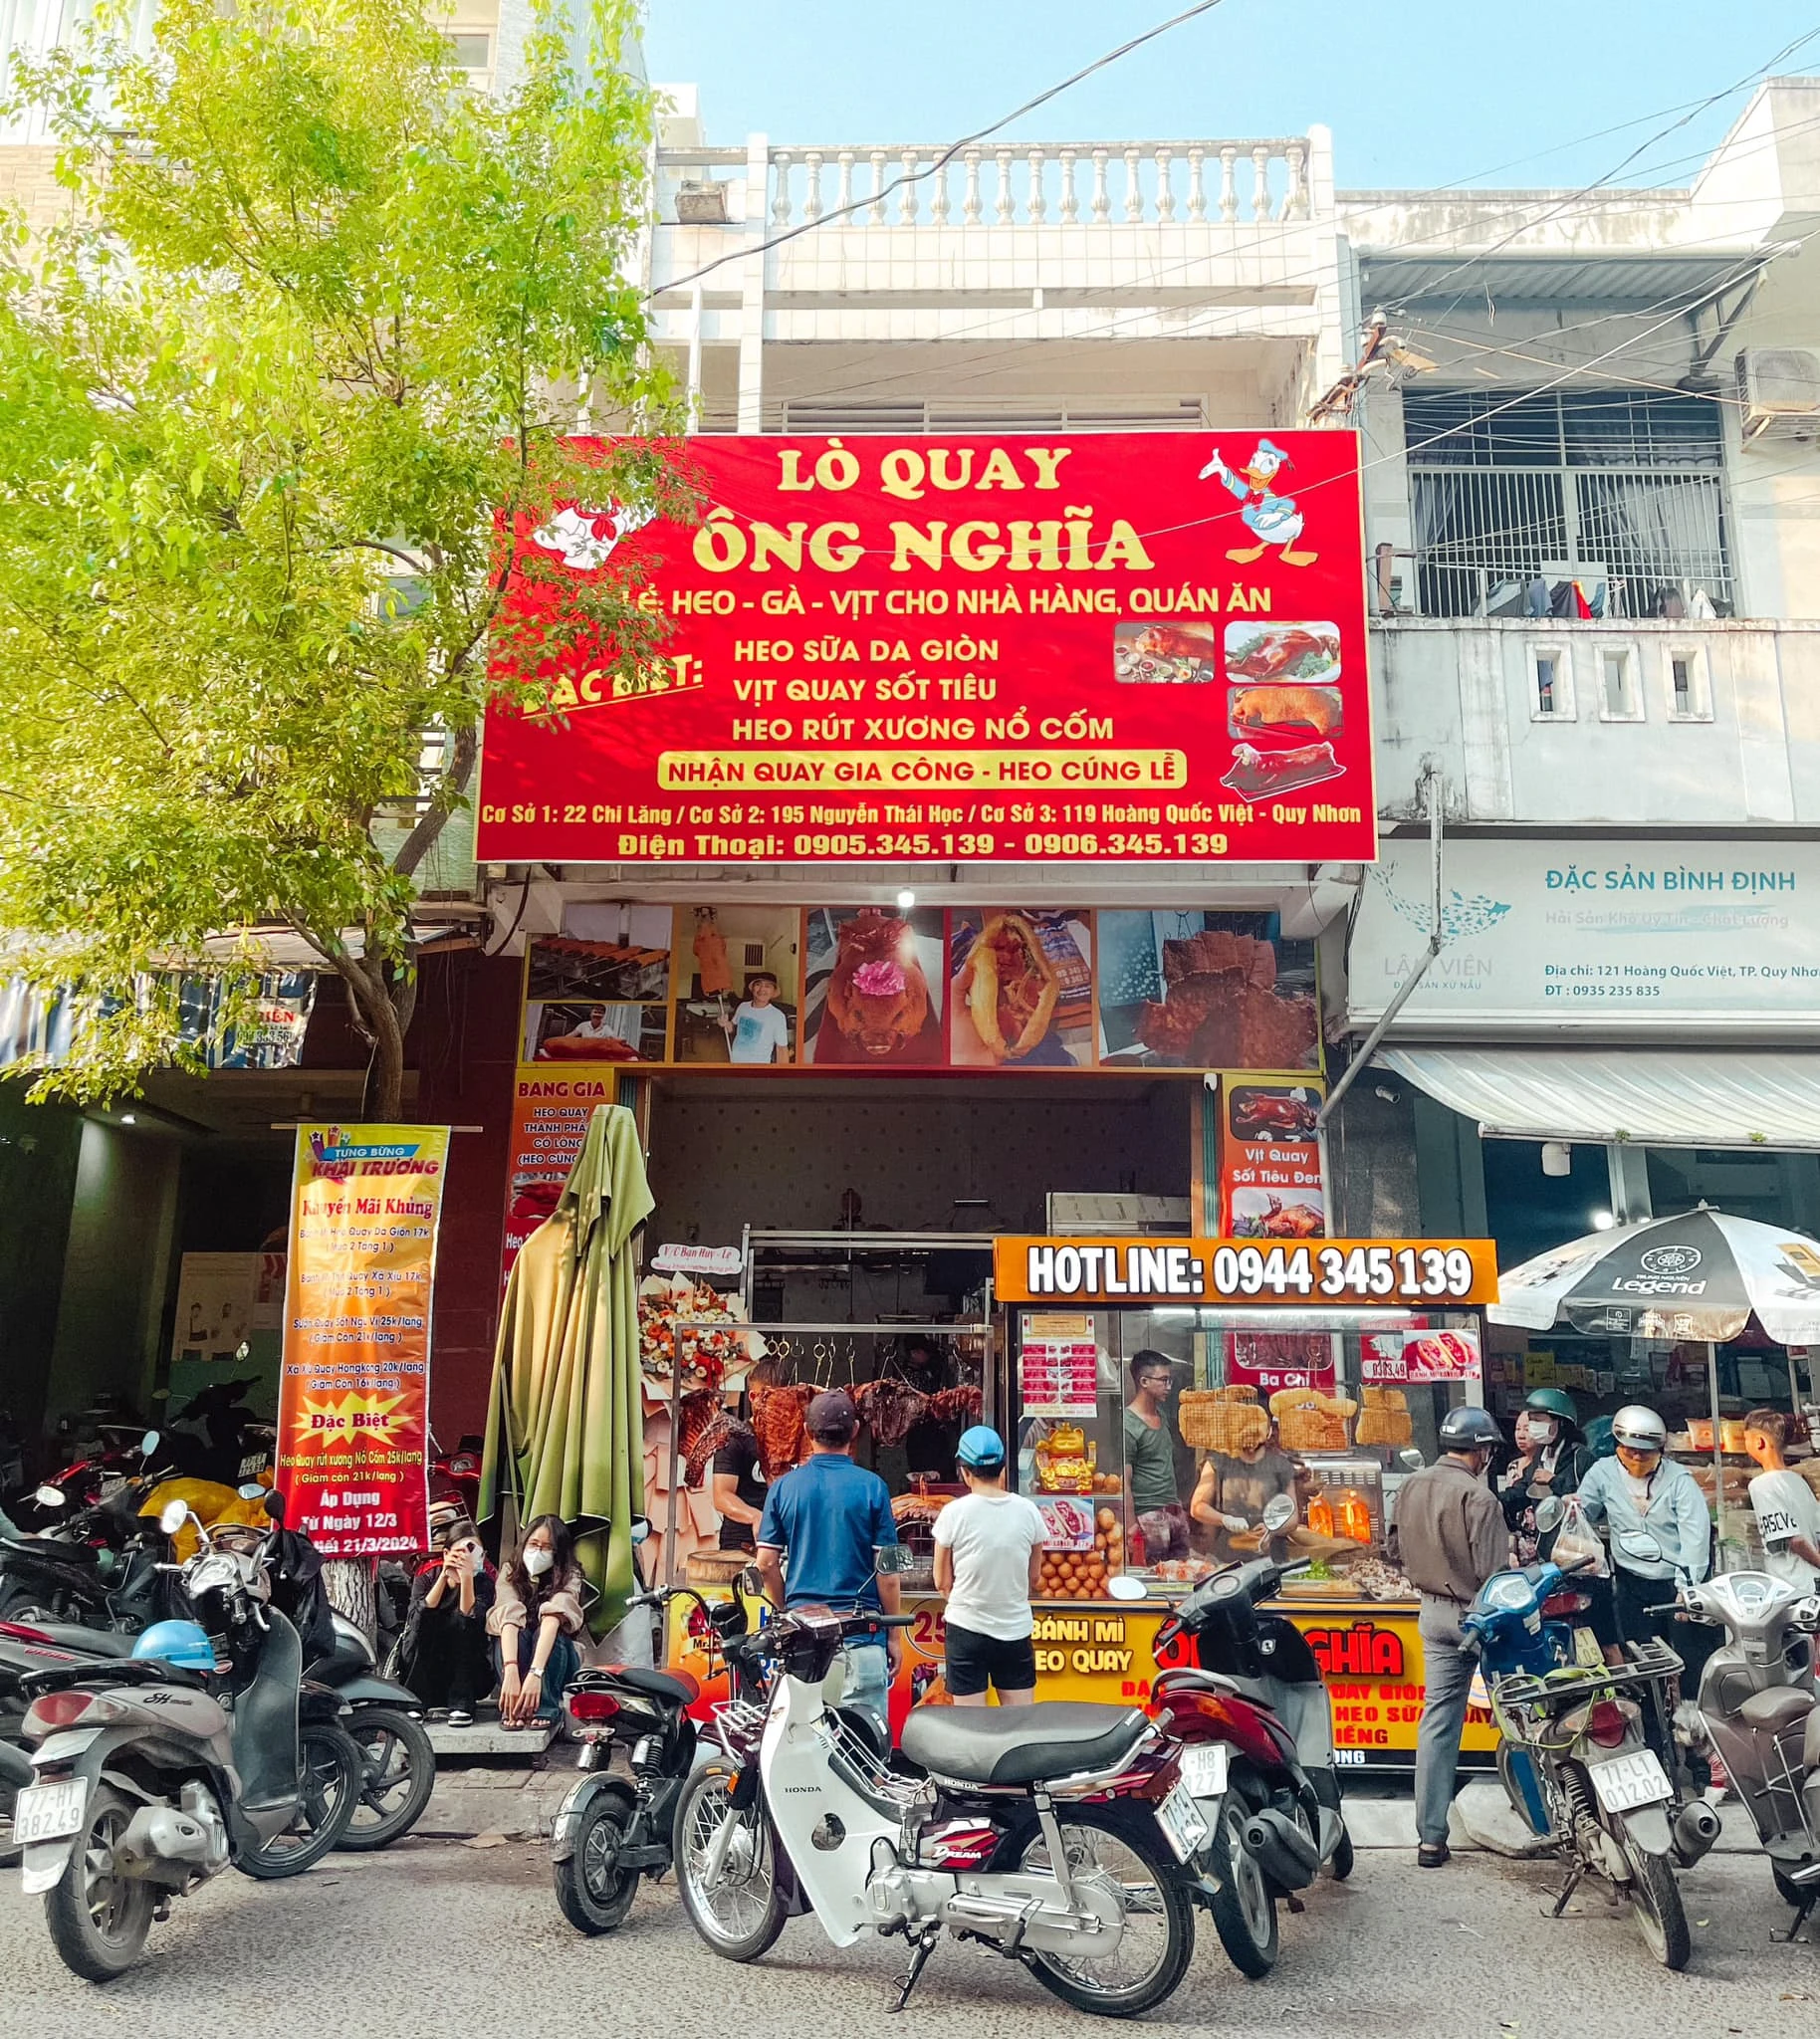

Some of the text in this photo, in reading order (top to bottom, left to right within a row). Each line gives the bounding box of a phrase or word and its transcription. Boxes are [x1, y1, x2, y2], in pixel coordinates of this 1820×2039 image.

[777, 438, 1071, 500] LÒ QUAY
[692, 506, 1155, 572] ÔNG NGHĨA
[672, 589, 736, 614] HEO
[761, 583, 805, 615] GÀ
[829, 589, 879, 621] VỊT
[885, 589, 949, 614] CHO
[957, 582, 1023, 614] NHÀ
[1029, 582, 1122, 616] HÀNG,
[1129, 581, 1219, 614] QUÁN
[1227, 582, 1270, 613] ĂN
[734, 633, 999, 662] HEO SỮA DA GIÒN
[733, 670, 997, 707] VỊT QUAY SỐT TIÊU
[732, 706, 1113, 741] HEO RÚT XƯƠNG NỔ CỐM
[668, 758, 746, 788] NHẬN
[754, 763, 824, 784] QUAY
[833, 763, 882, 783] GIA
[891, 757, 974, 783] CÔNG
[999, 762, 1051, 782] HEO
[1060, 756, 1141, 782] CÚNG
[1150, 752, 1175, 782] LỄ
[482, 801, 1361, 826] Cơ Sở 1: 22 Chi Lăng Cơ Sở 2: 195 Nguyễn Thái Học Cơ Sở 3: 119 Hoàng Quốc Việt Quy Nhơn
[617, 833, 1228, 859] Điện Thoại: 0905.345.139 0906.345.139
[1545, 863, 1796, 895] ĐẶC SẢN BÌNH ĐỊNH
[1440, 954, 1491, 976] VIÊN
[1597, 966, 1619, 976] 121
[1624, 965, 1667, 979] Hoàng
[1670, 963, 1704, 978] Quốc
[1761, 966, 1787, 980] Quy
[1791, 966, 1820, 977] Nhơ
[1545, 985, 1660, 996] ĐT 0935 235 835
[534, 1108, 588, 1117] HEO QUAY
[1246, 1148, 1308, 1165] Vịt Quay
[1259, 1170, 1289, 1183] Tiêu
[355, 1197, 433, 1219] Mãi Khủng
[413, 1228, 430, 1237] 17k
[1026, 1246, 1474, 1295] HOTLINE: 0944 345 139
[1612, 1277, 1707, 1294] Legend
[1258, 1372, 1280, 1387] Ba
[311, 1413, 390, 1432] Đặc Biệt
[280, 1455, 295, 1467] Heo
[342, 1491, 380, 1508] Dụng
[323, 1514, 360, 1531] Ngày
[366, 1513, 397, 1528] 12/3
[343, 1536, 418, 1553] 21/3/2024
[1029, 1616, 1124, 1643] BÁNH MÌ
[1034, 1650, 1133, 1673] EO QUAY
[1335, 1706, 1378, 1722] HEO
[944, 1778, 979, 1791] HONDA
[1606, 1775, 1669, 1808] 012.02
[20, 1807, 81, 1838] 382.49
[932, 1845, 982, 1860] DREAM
